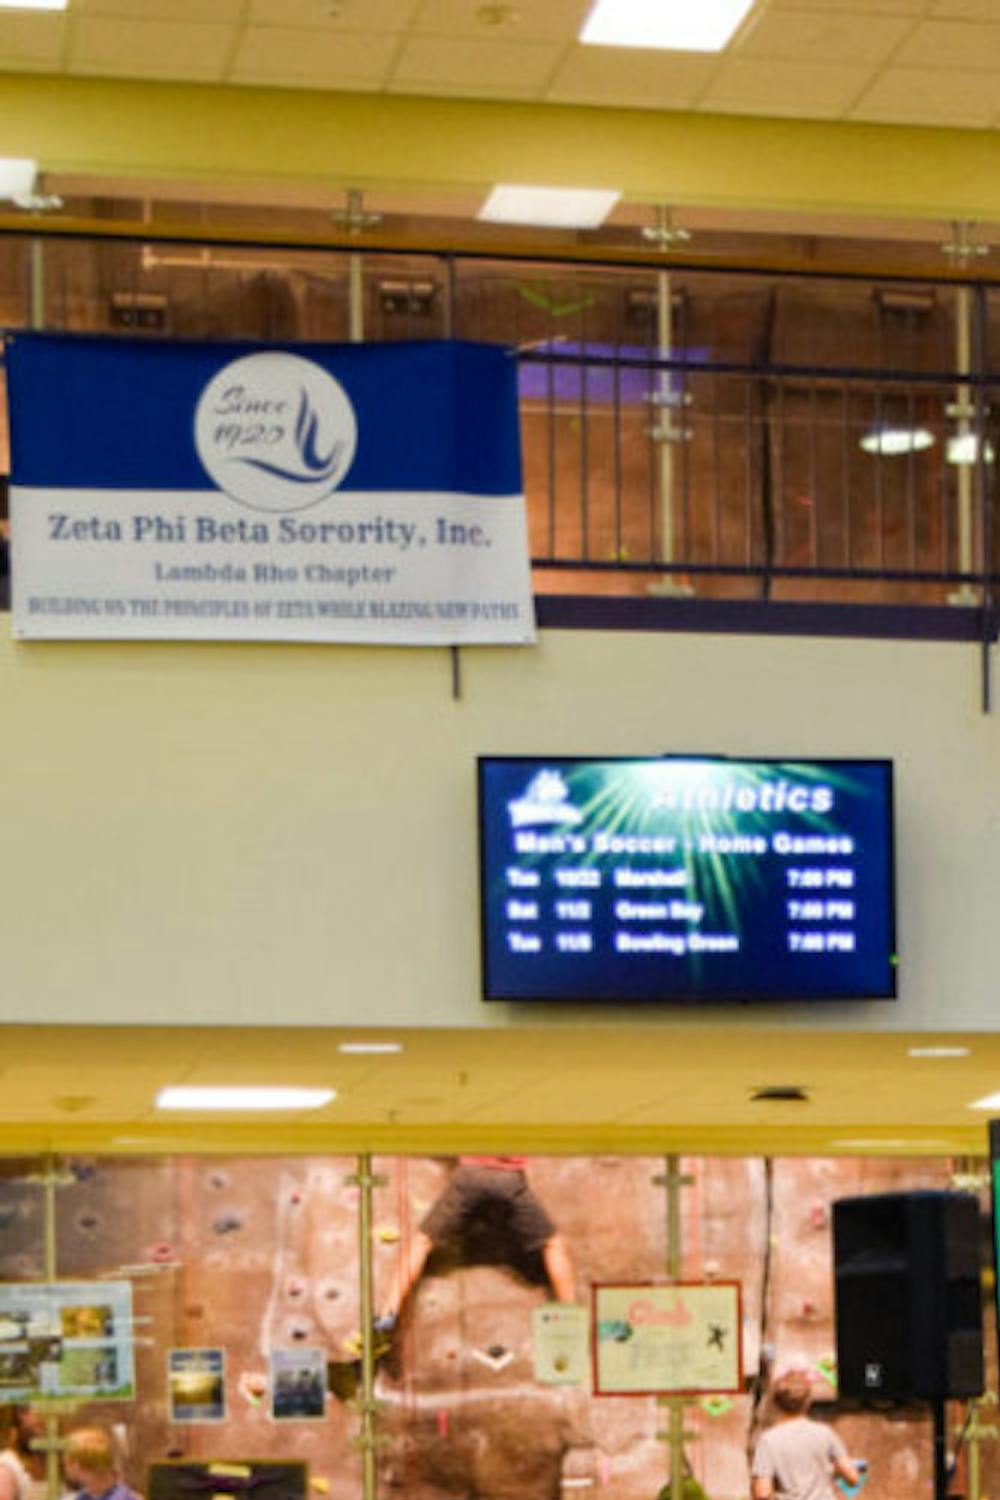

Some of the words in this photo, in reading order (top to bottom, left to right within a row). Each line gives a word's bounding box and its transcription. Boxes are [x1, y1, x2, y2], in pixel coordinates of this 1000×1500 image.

[214, 384, 287, 415] Since
[48, 515, 121, 540] Zeta
[134, 516, 186, 542] Phi
[196, 517, 269, 543] Beta
[436, 517, 492, 546] Inc.
[155, 563, 246, 582] Lambda
[254, 563, 297, 582] Rho
[304, 564, 395, 587] Chapter
[652, 779, 833, 812] Athletics
[514, 832, 586, 853] Men's
[592, 832, 676, 853] Soccer
[700, 835, 767, 853] Home
[772, 832, 853, 853] Games
